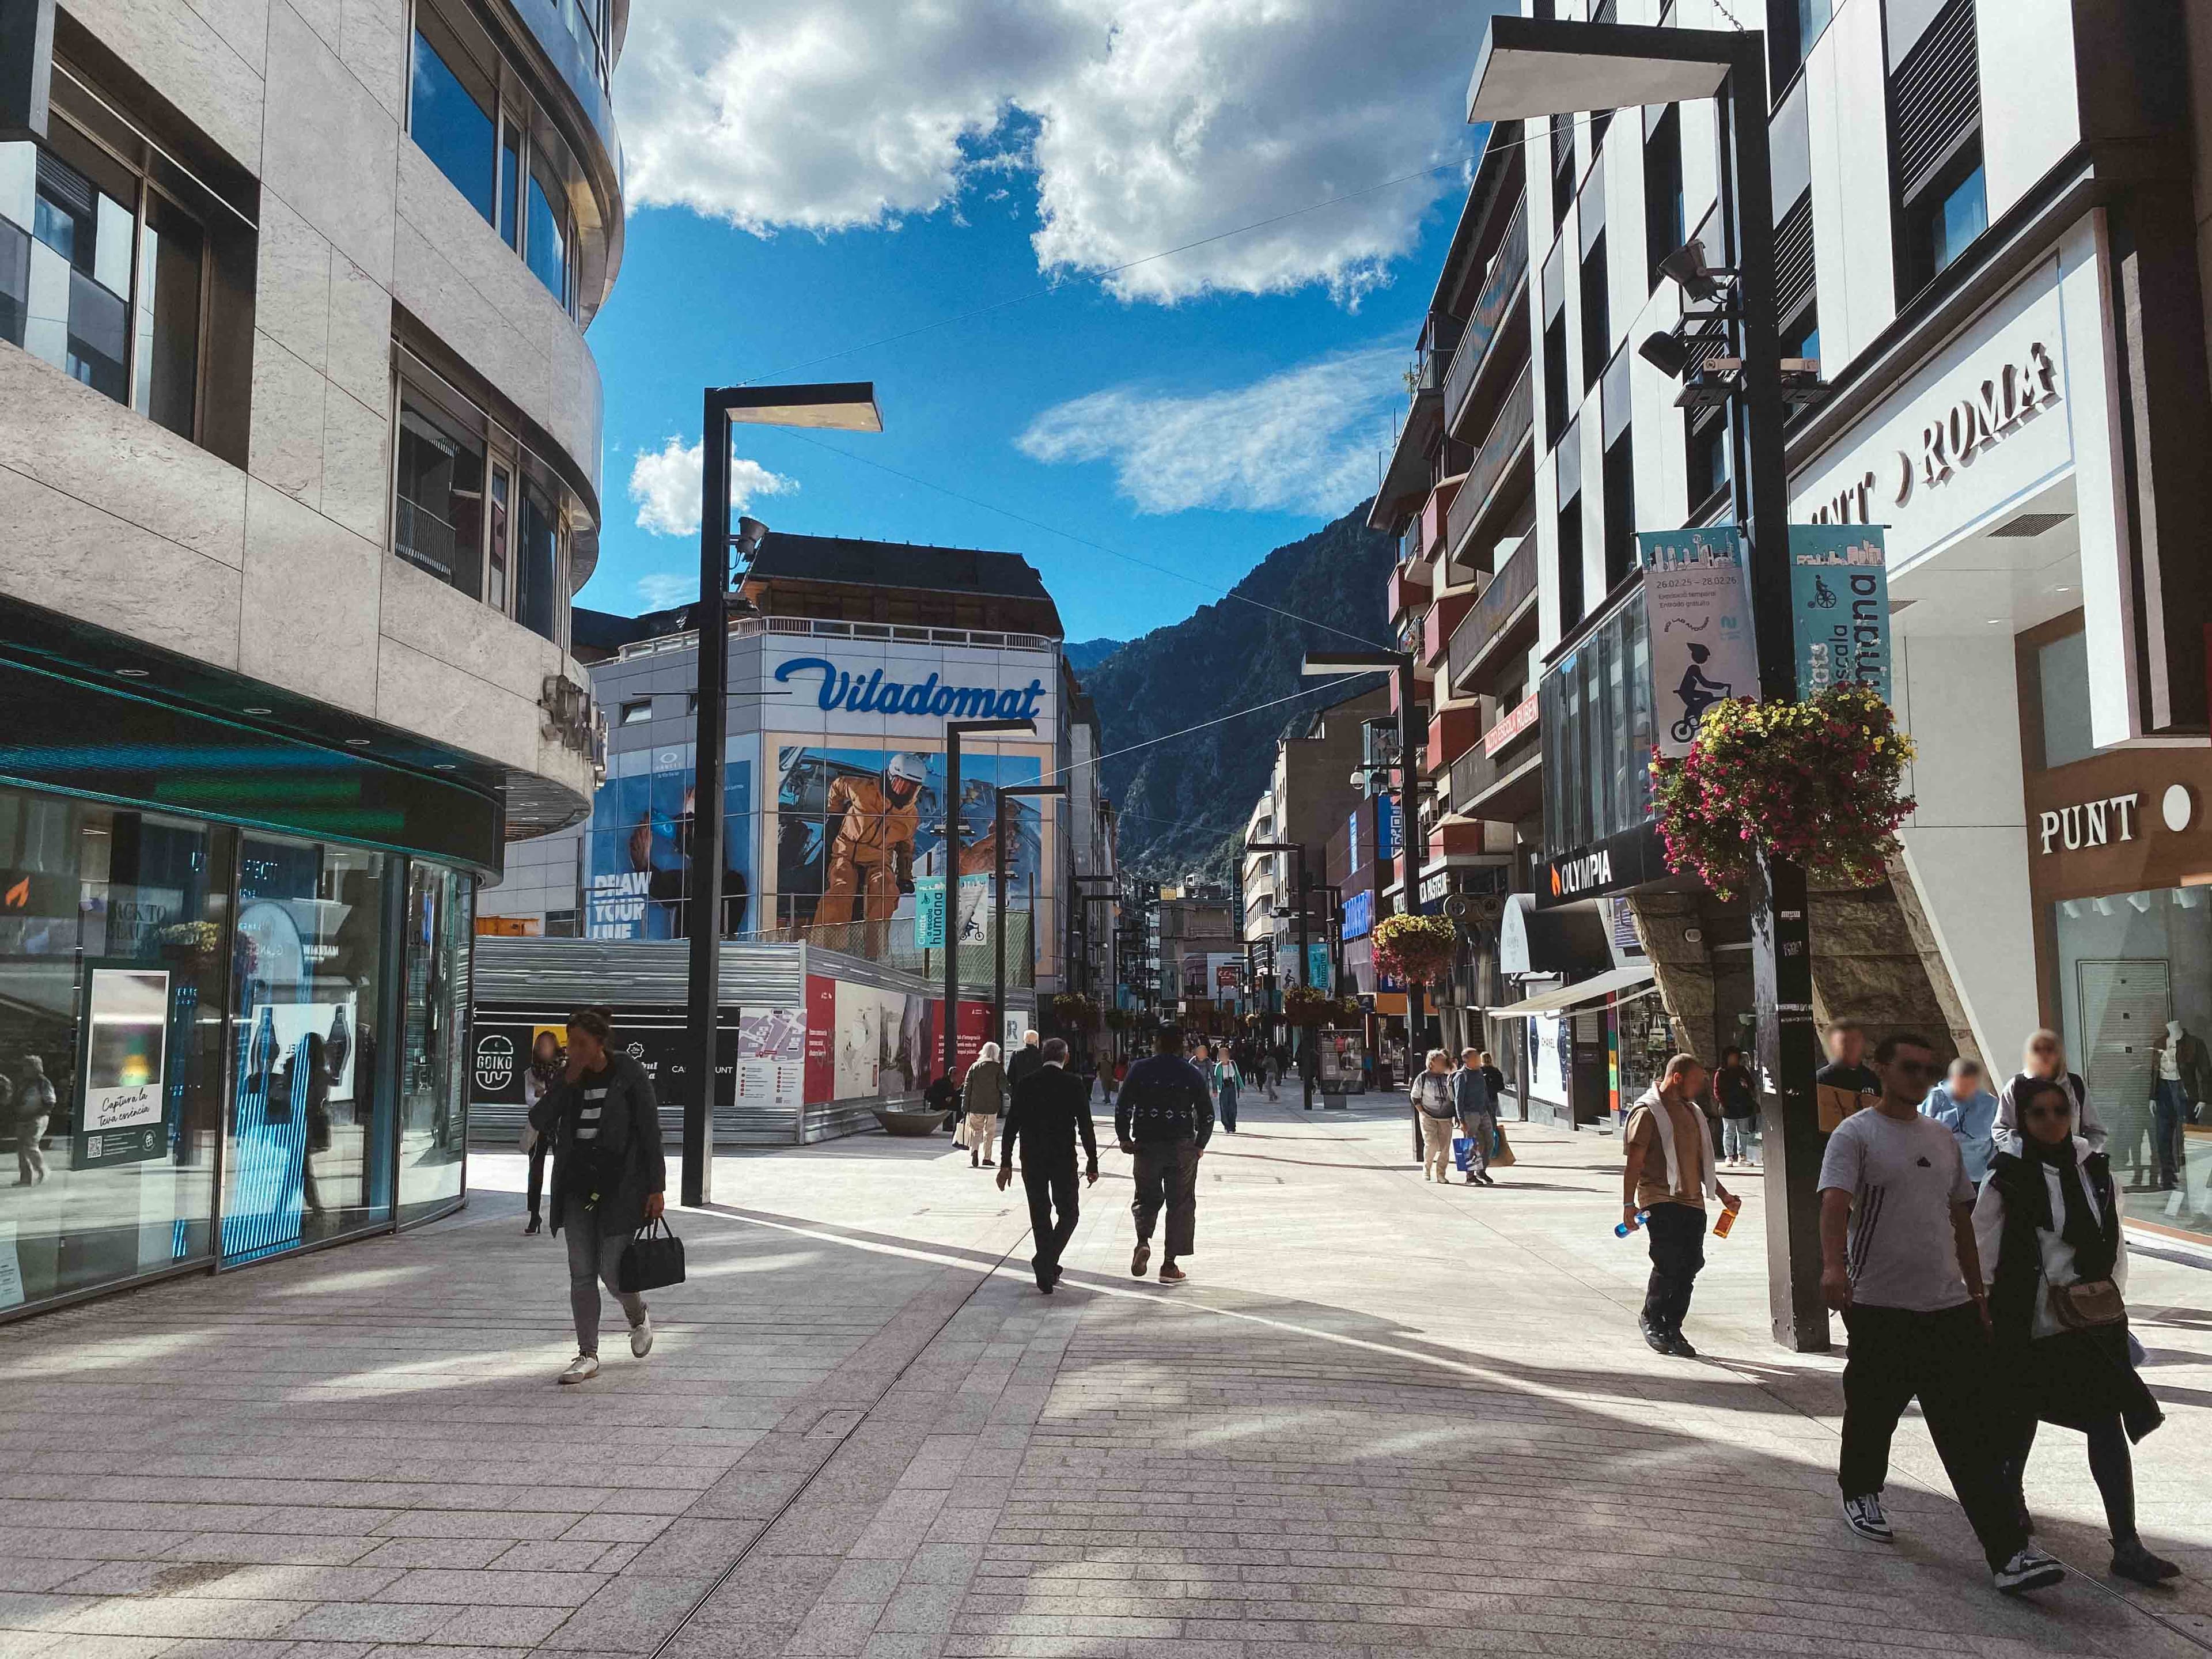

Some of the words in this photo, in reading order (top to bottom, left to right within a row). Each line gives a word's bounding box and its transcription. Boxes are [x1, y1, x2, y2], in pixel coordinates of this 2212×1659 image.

[1922, 342, 2060, 487] ROMA
[1828, 624, 1849, 680] scala
[1850, 574, 1880, 687] mana
[774, 657, 1046, 719] Viladomat
[2040, 793, 2138, 855] PUNT
[594, 871, 652, 897] DRAW
[1427, 872, 1448, 902] PASTEUR
[1561, 849, 1613, 895] OLYMPIA
[593, 897, 645, 922] YOUR
[929, 892, 943, 945] humana
[477, 1056, 513, 1069] GOIKO
[102, 1094, 138, 1113] Captura
[139, 1088, 148, 1100] la
